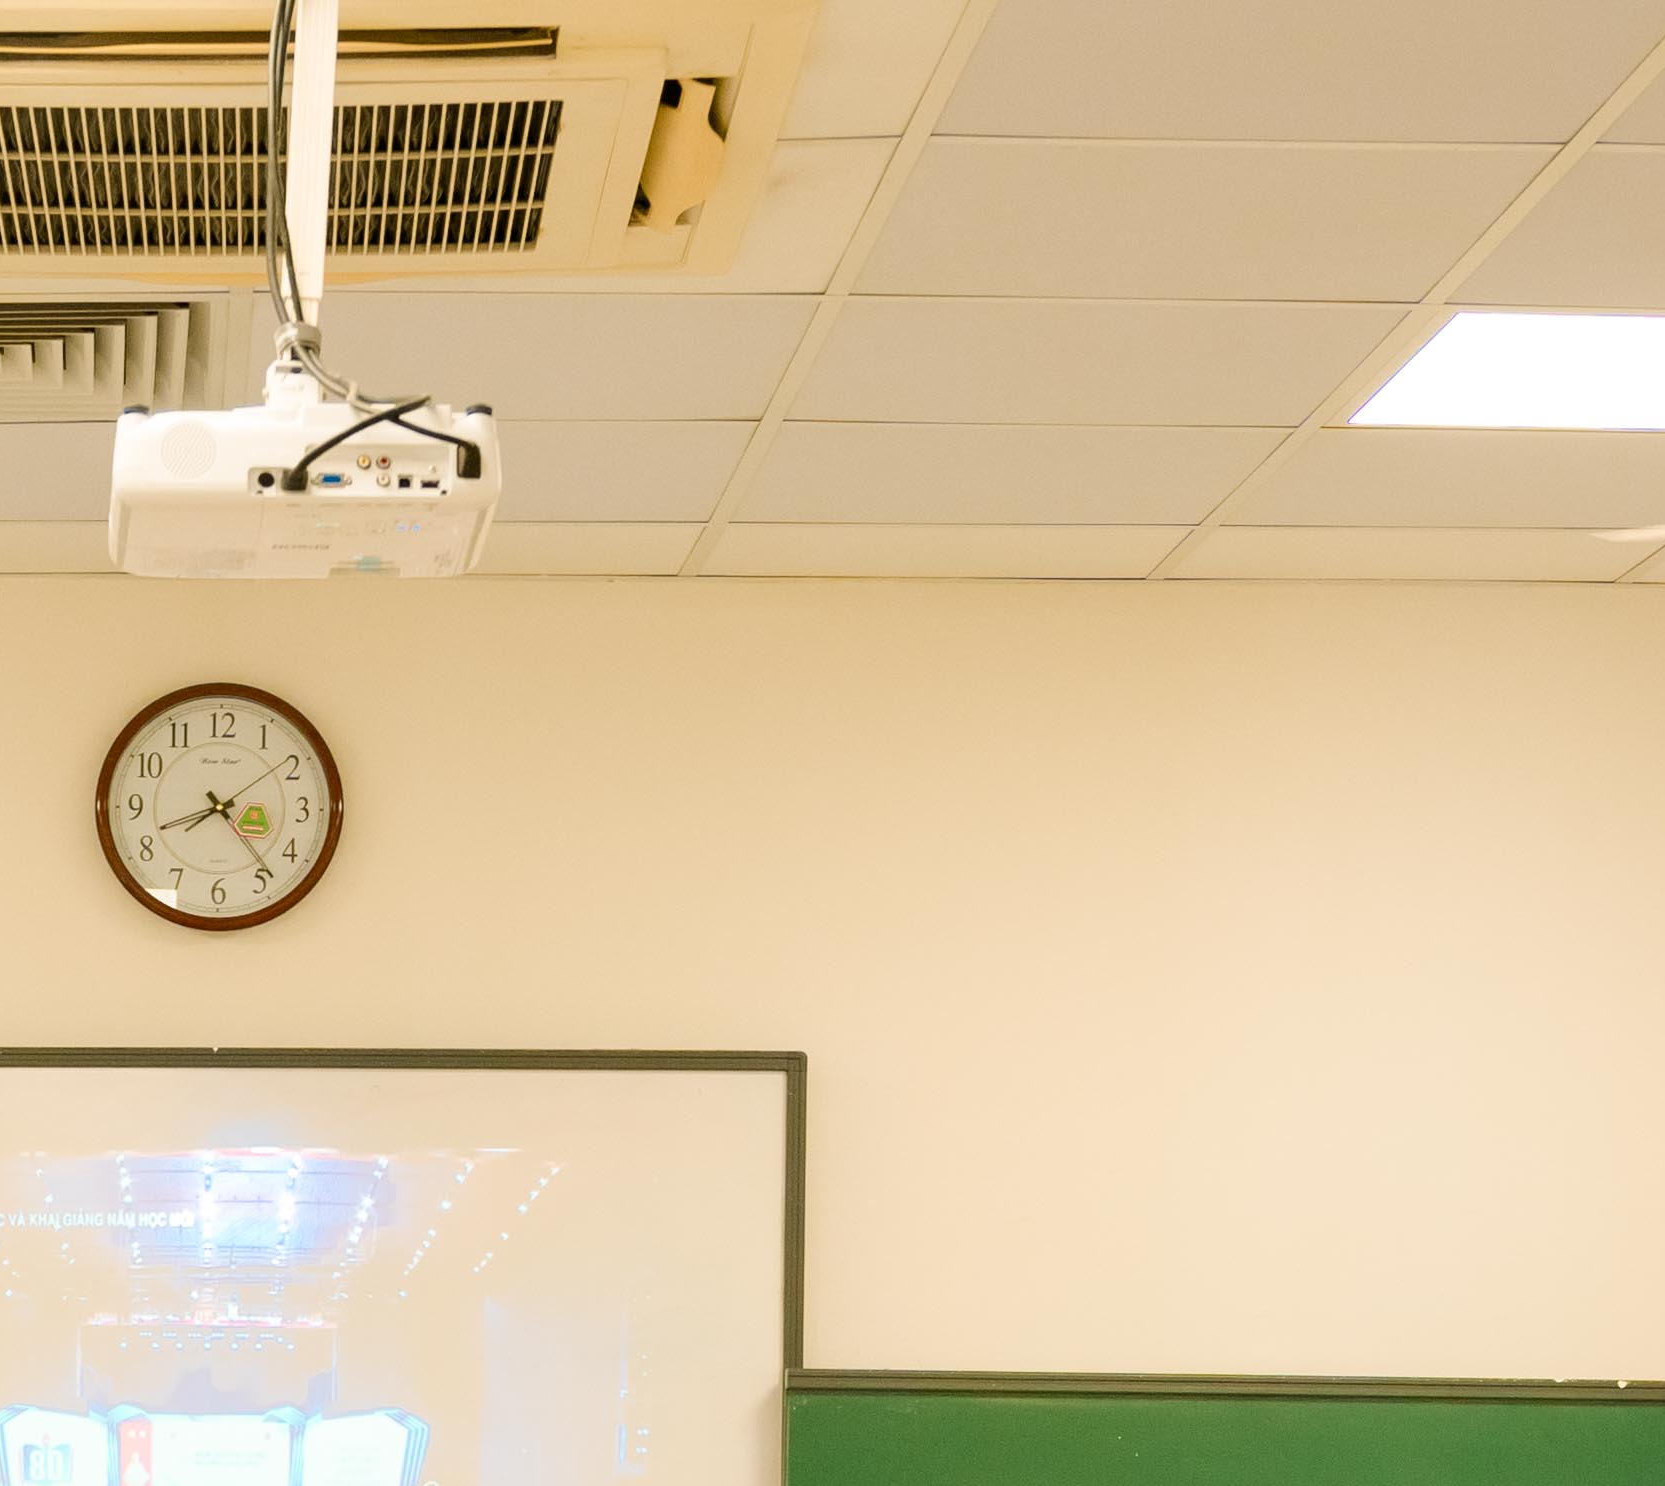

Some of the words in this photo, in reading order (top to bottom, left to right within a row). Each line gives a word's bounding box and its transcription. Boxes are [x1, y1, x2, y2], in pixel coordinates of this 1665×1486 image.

[168, 721, 190, 749] 11
[209, 712, 237, 739] 12
[259, 724, 269, 750] 1
[137, 751, 163, 779] 10
[284, 754, 301, 781] 2
[128, 793, 144, 821] 9
[295, 796, 310, 823] 3
[139, 835, 154, 862] 8
[282, 837, 298, 864] 4
[168, 867, 184, 891] 7
[210, 877, 227, 905] 6
[252, 868, 270, 894] 5
